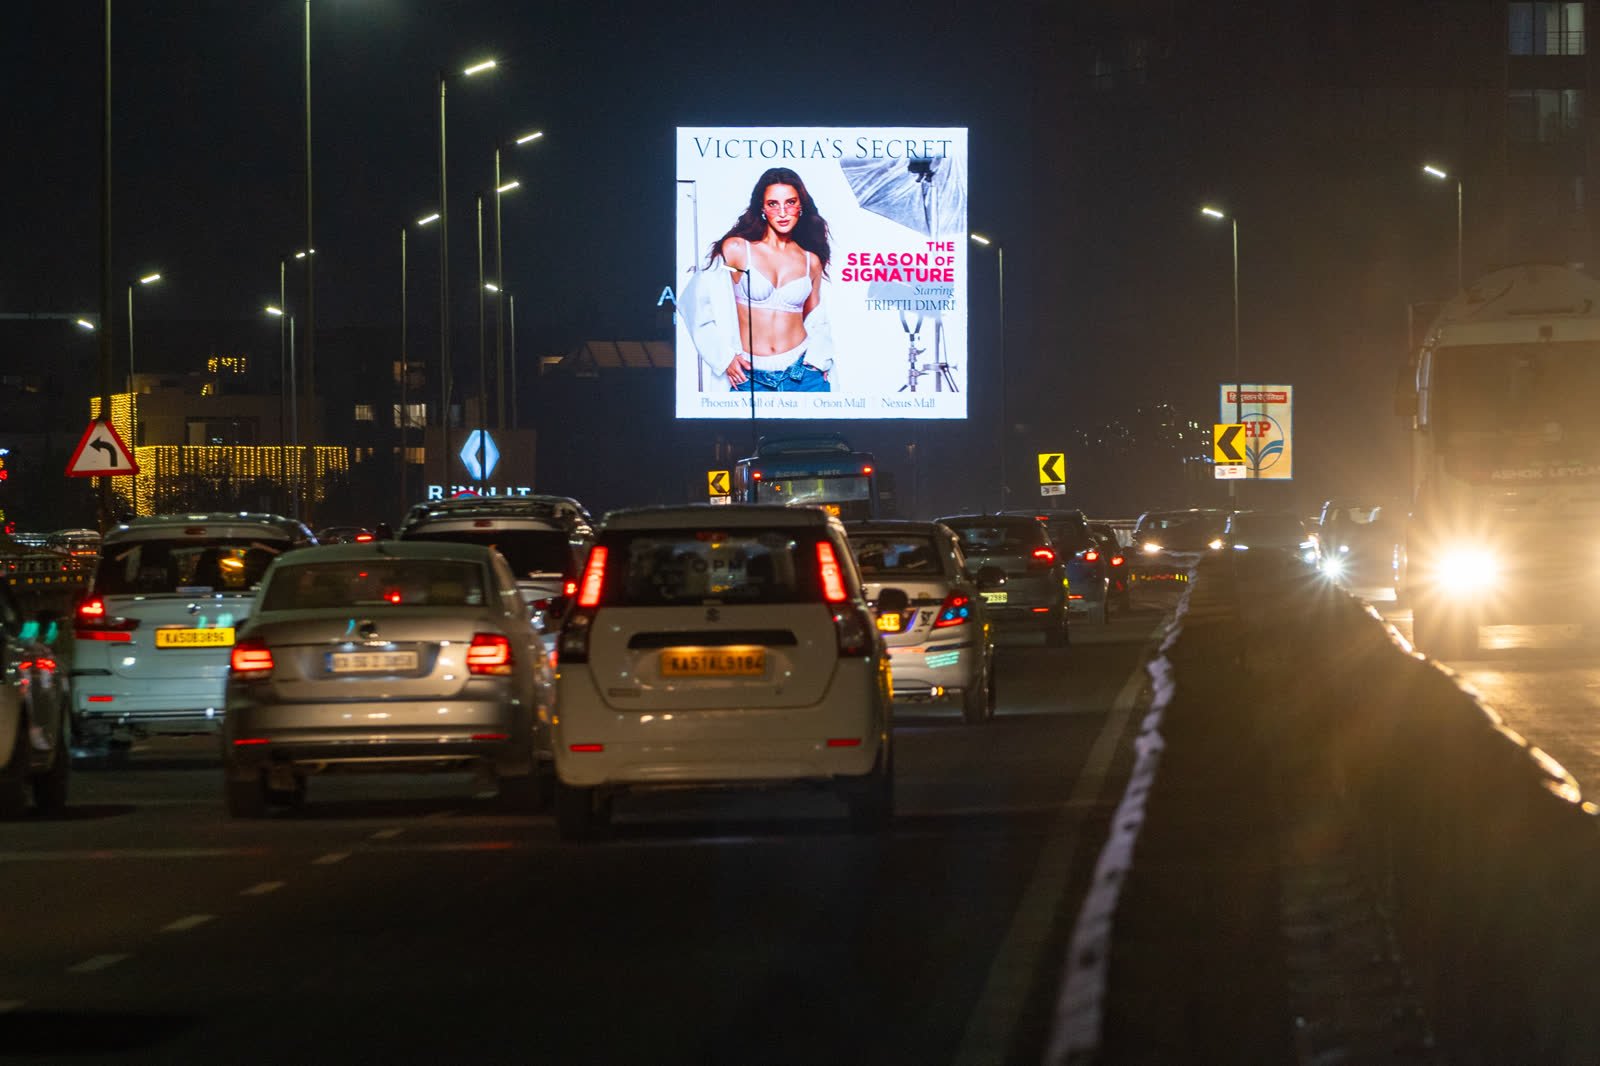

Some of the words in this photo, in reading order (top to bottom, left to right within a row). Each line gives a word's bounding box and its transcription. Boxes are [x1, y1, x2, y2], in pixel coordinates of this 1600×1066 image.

[693, 137, 843, 159] VICTORIA'S
[855, 137, 953, 159] SECRET
[926, 241, 955, 252] THE
[847, 252, 928, 266] SEASON
[934, 256, 955, 266] OF
[841, 268, 955, 282] SIGNATURE
[913, 285, 955, 299] Starring
[865, 299, 912, 311] TRIPTII
[915, 299, 956, 311] DIMRI
[701, 397, 739, 408] Phoenix
[741, 397, 763, 408] Mll
[764, 397, 774, 408] of
[777, 397, 798, 408] Asia
[813, 397, 843, 408] Orion
[844, 397, 866, 408] Mall
[881, 397, 912, 408] Nexus
[914, 397, 935, 408] Mall
[1241, 421, 1272, 437] HP
